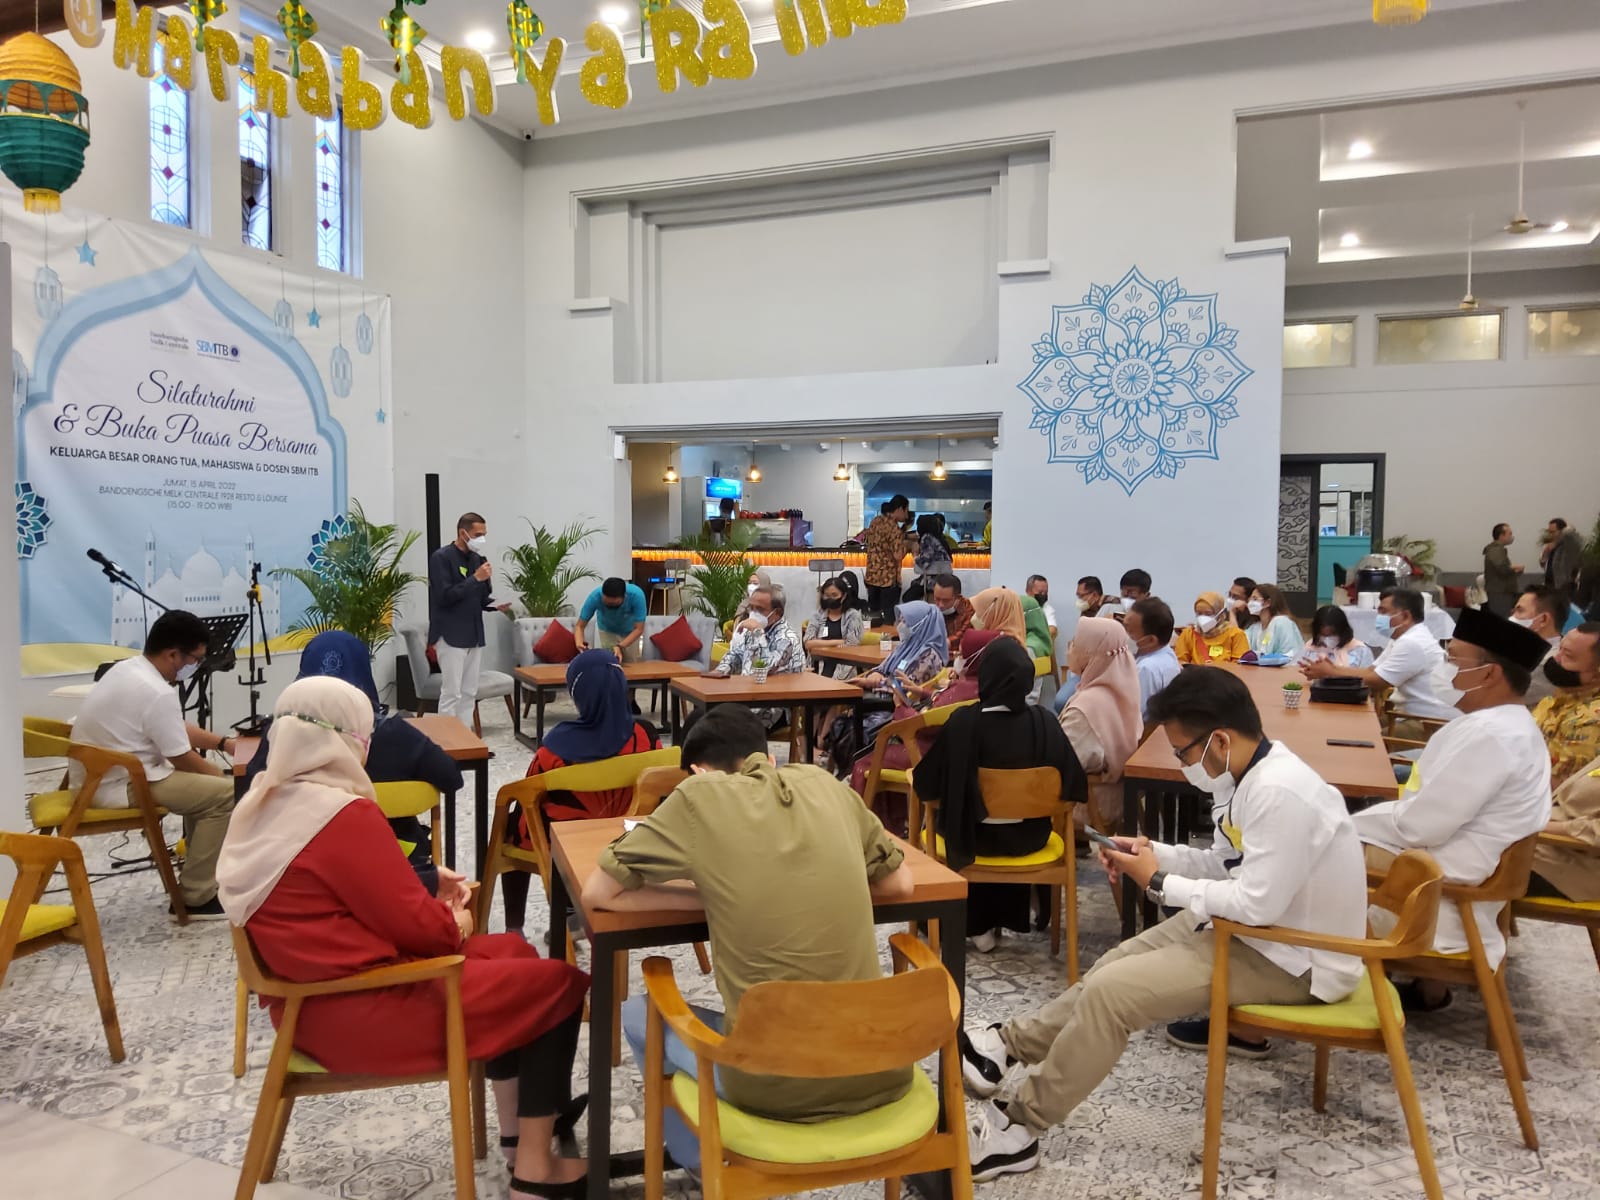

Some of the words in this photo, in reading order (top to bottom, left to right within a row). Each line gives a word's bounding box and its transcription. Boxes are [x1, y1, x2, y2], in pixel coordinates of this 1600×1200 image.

[137, 369, 256, 414] Silaturahmi
[53, 403, 81, 434] &
[84, 404, 159, 441] Buka
[164, 413, 232, 447] Puasa
[238, 422, 319, 456] Bersama
[49, 446, 107, 460] KELUARGA
[108, 450, 140, 463] BESAR
[142, 453, 178, 466] ORANG
[180, 456, 200, 468] TUA,
[201, 458, 254, 471] MAHASISWA
[263, 463, 290, 475] DOSEN
[291, 465, 307, 476] SBM
[307, 467, 319, 477] ITB
[99, 485, 162, 497] BANDOENGSCHE
[163, 489, 182, 498] MELK
[184, 490, 219, 500] CENTRALE
[235, 493, 256, 502] RESTO
[262, 494, 288, 503] LOUNGE
[198, 480, 216, 489] APRIL
[218, 481, 236, 490] 2022
